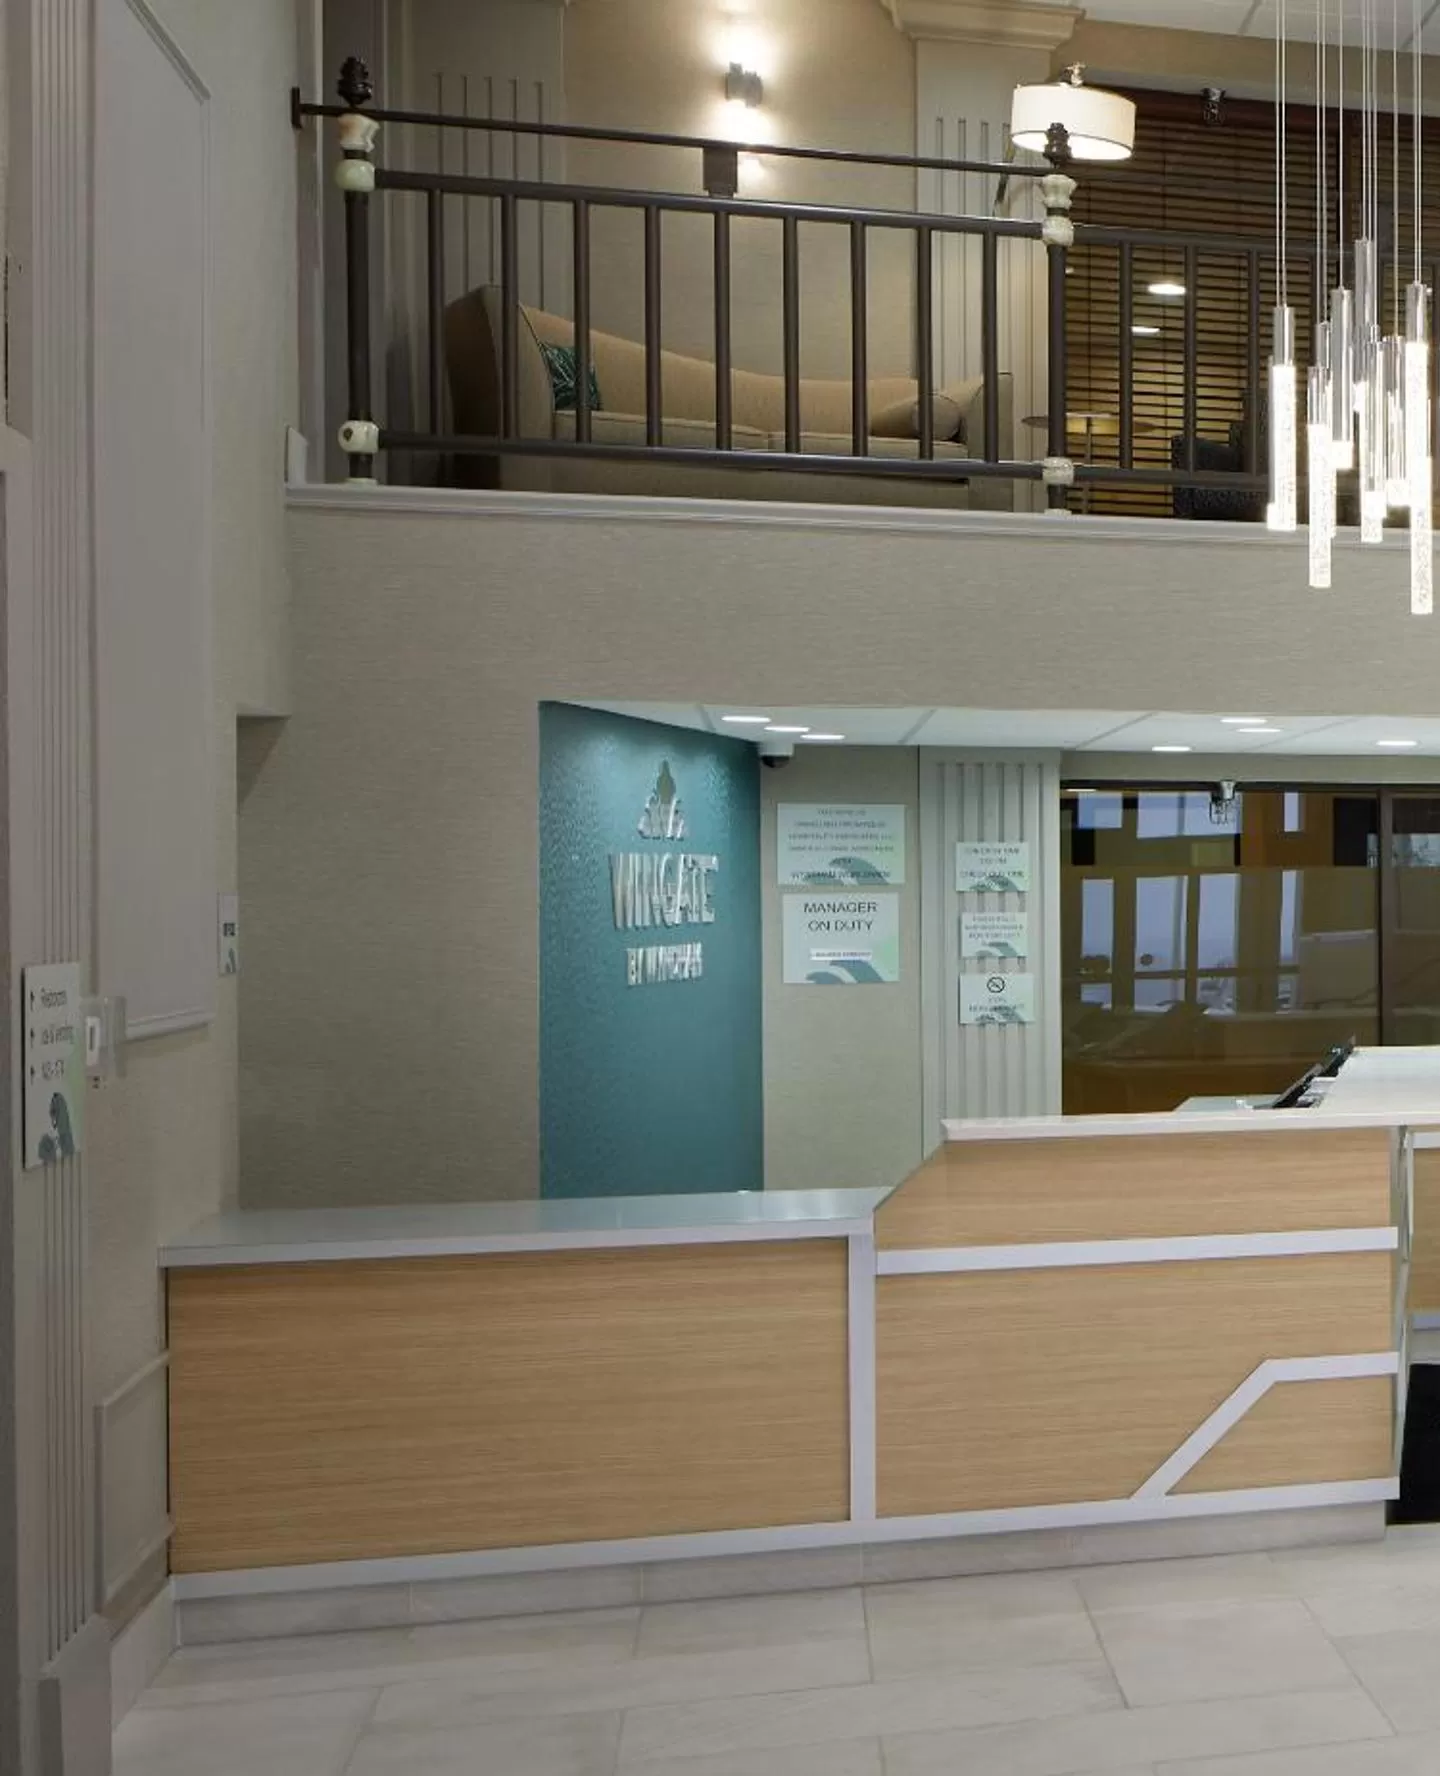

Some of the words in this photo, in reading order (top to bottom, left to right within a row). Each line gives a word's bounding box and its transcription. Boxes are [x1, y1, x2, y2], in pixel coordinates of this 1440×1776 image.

[609, 852, 719, 929] WINGATE
[803, 901, 877, 913] MANAGER
[808, 919, 830, 931] ON
[834, 919, 873, 931] DUTY
[627, 947, 645, 986] BY
